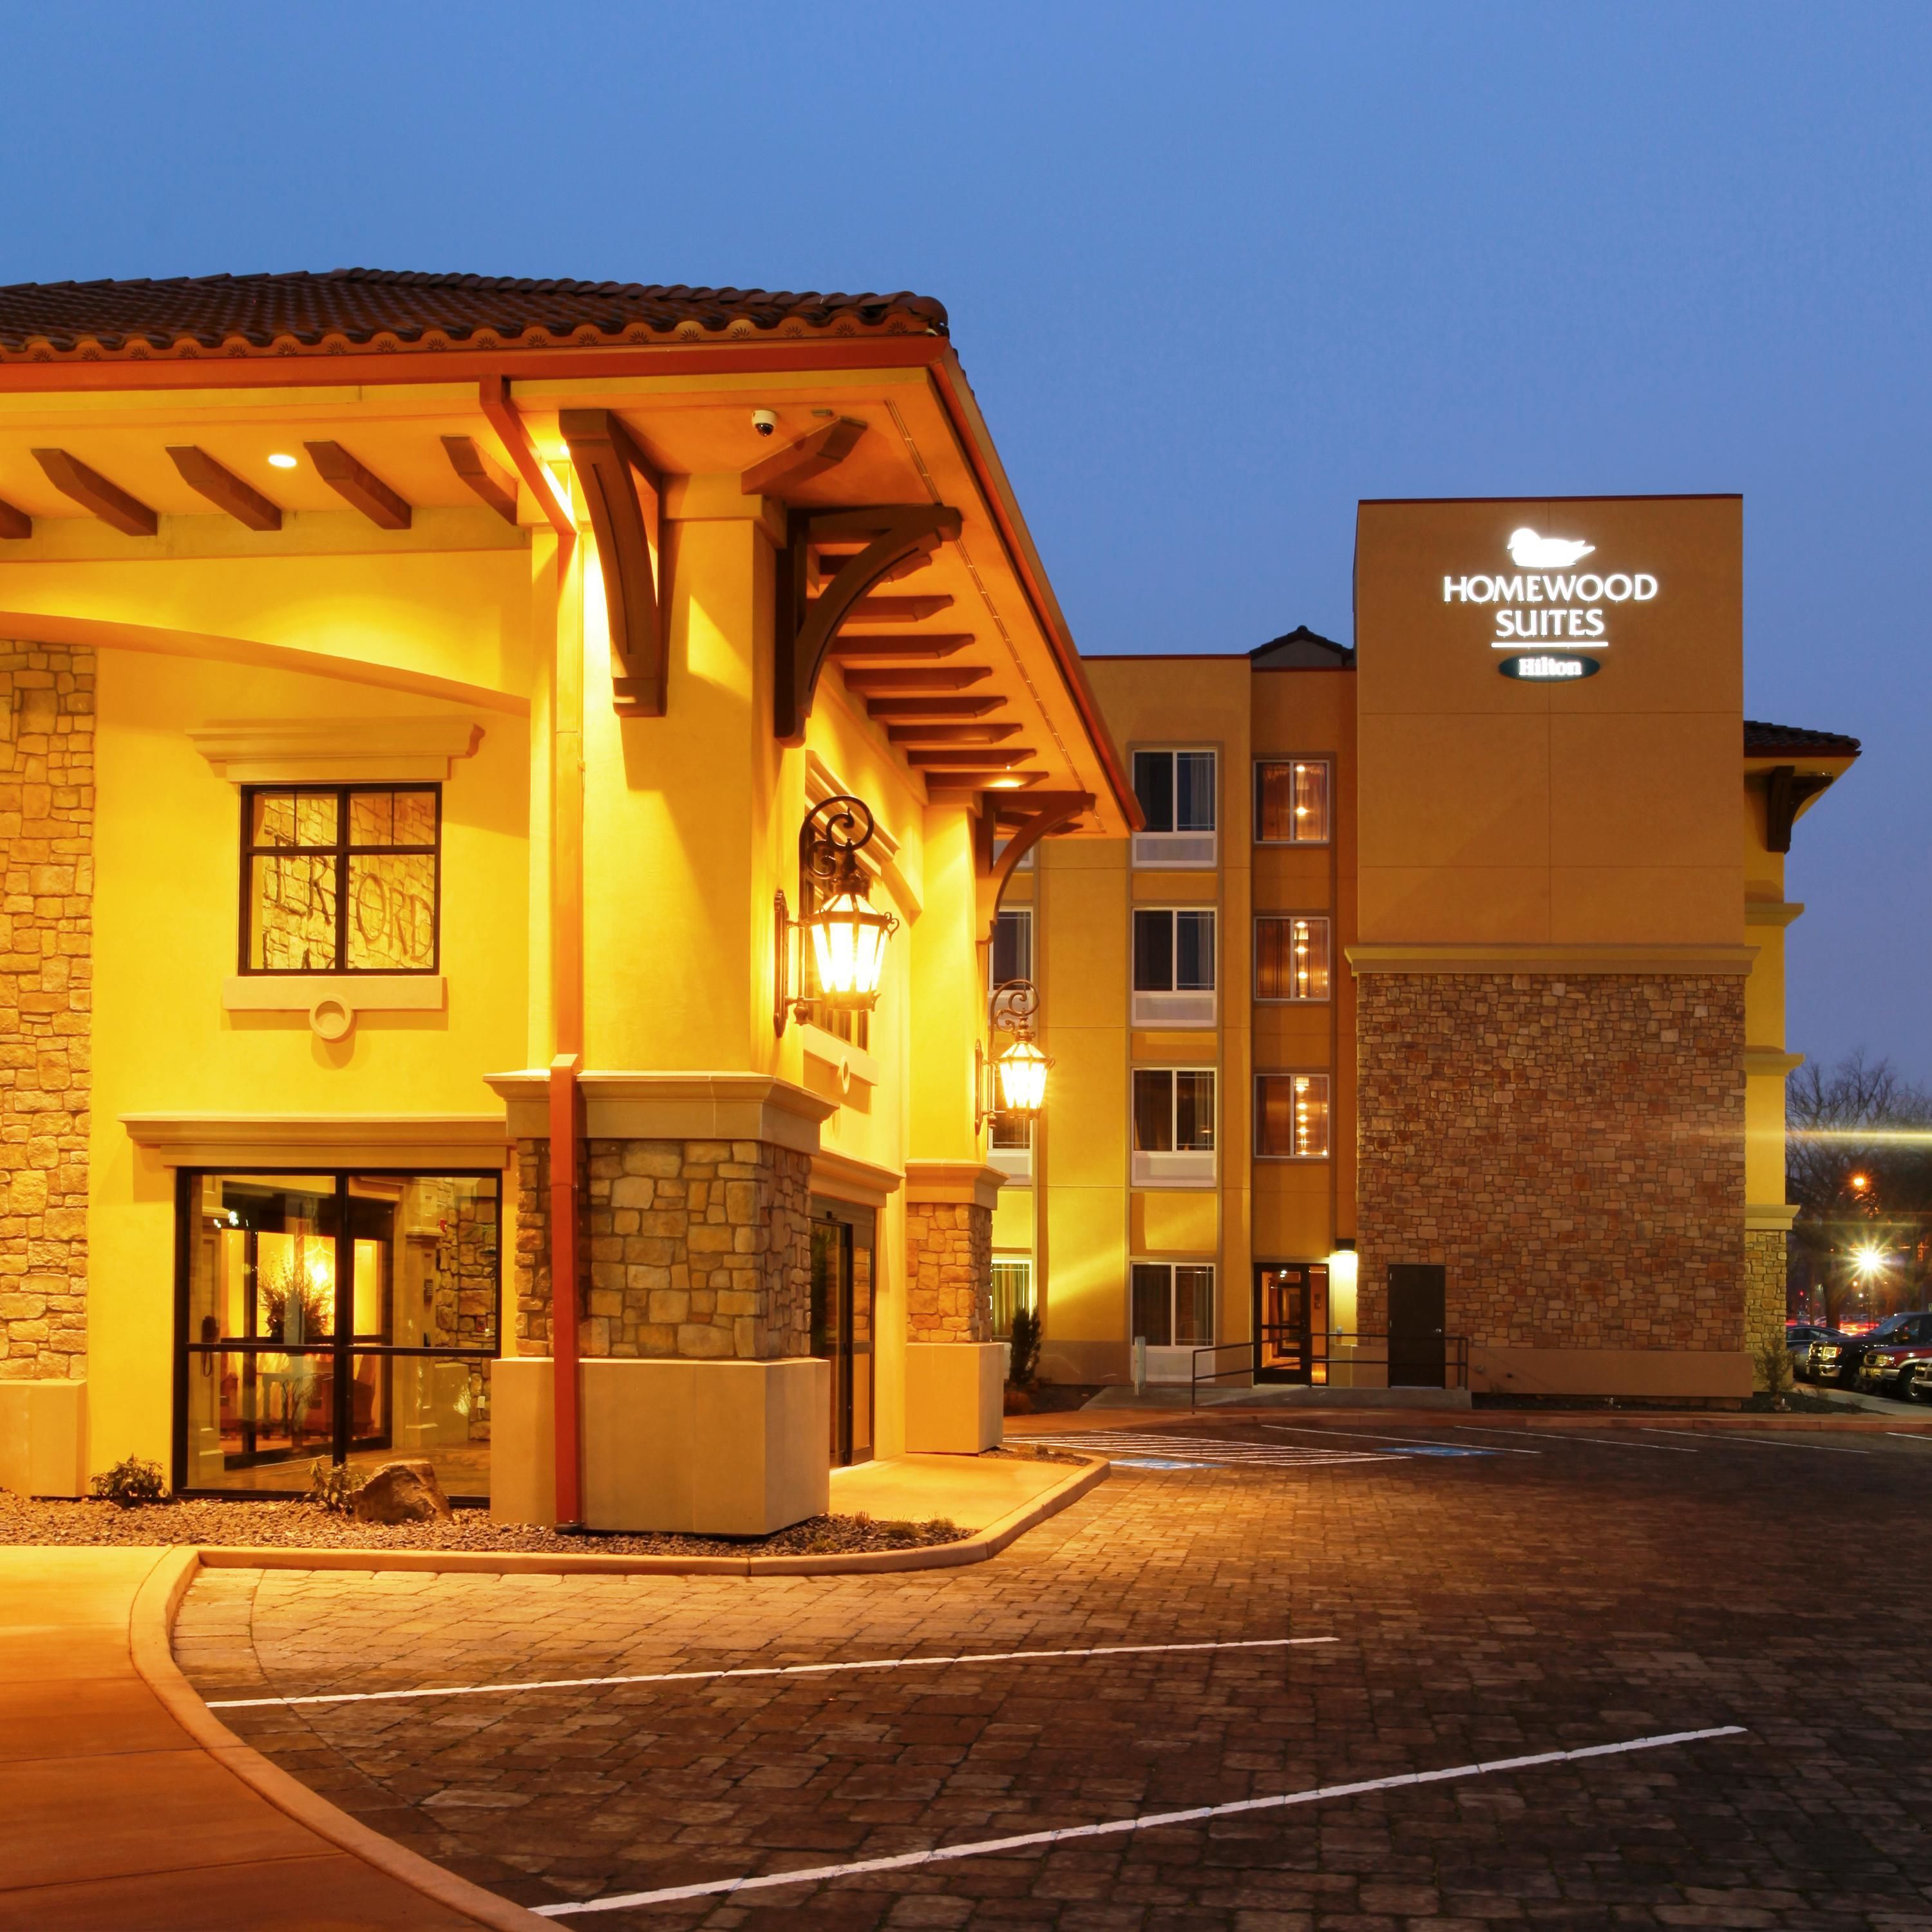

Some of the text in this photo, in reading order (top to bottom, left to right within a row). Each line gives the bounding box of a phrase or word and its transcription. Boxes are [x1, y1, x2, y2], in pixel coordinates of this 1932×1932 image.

[1443, 574, 1658, 603] HOMEWOOD
[1495, 609, 1605, 637] SUITES
[1518, 656, 1582, 676] Hilton
